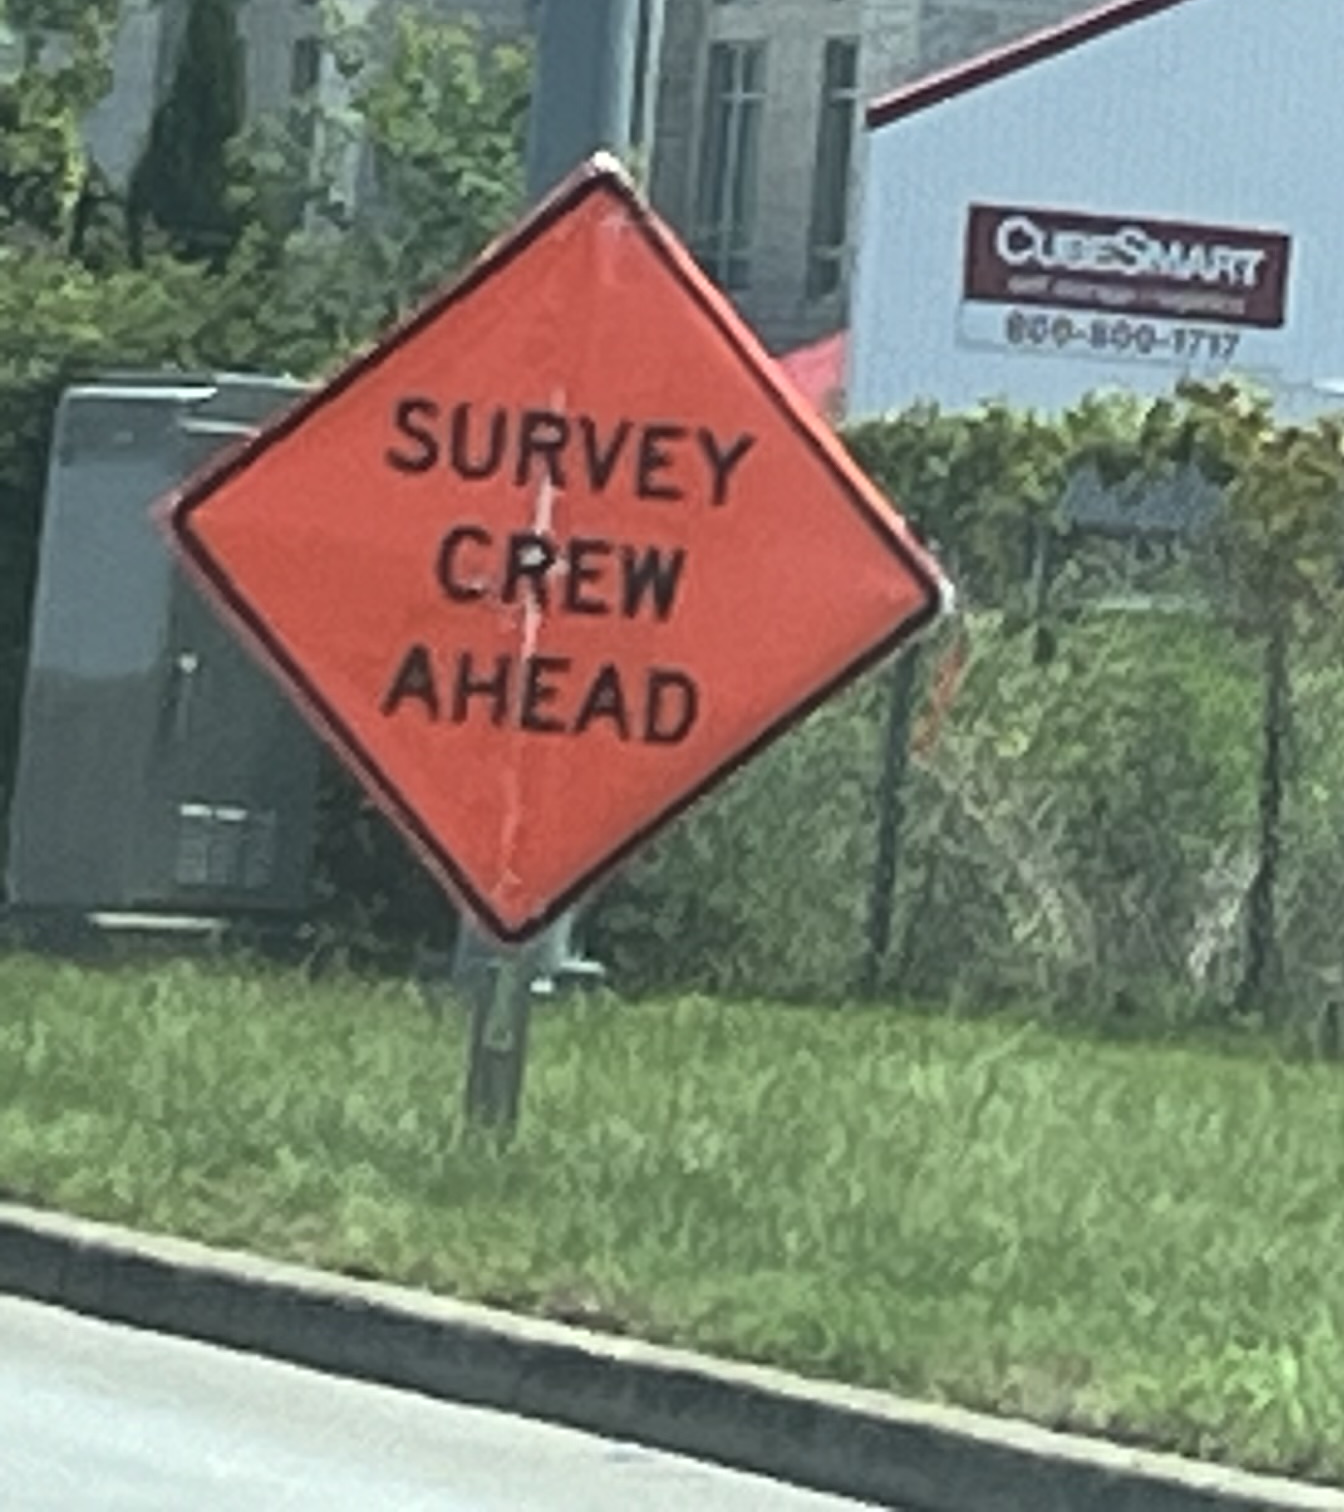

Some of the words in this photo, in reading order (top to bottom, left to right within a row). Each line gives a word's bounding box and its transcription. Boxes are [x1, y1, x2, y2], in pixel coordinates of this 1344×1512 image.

[384, 396, 757, 507] SURVEY
[435, 524, 689, 623] CREW
[380, 644, 701, 747] AHEAD
